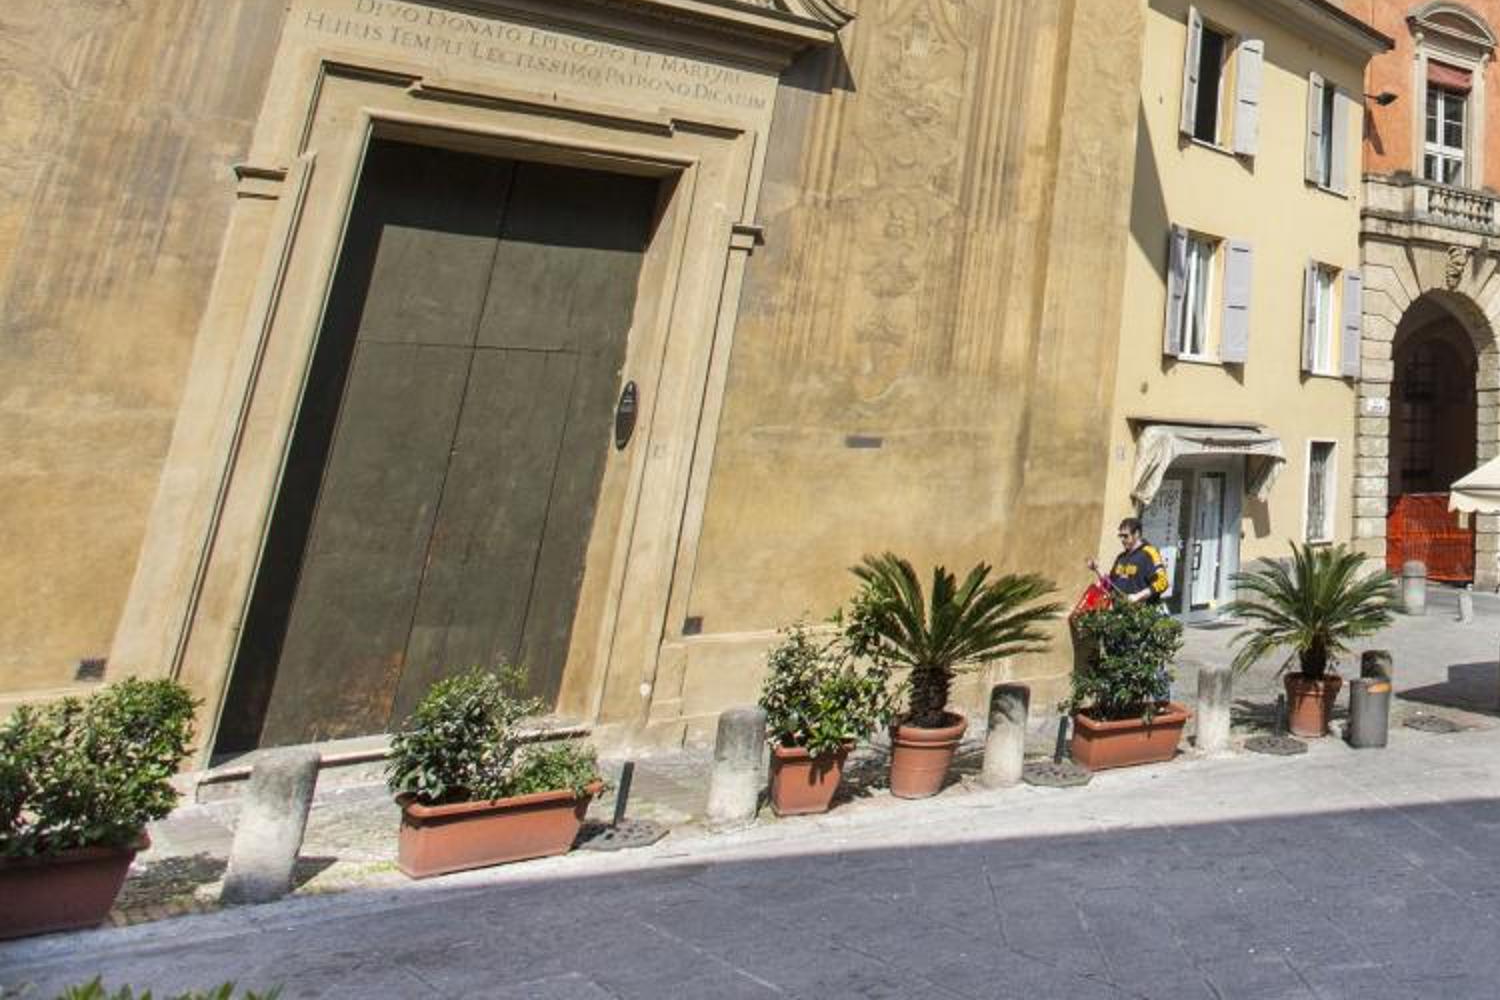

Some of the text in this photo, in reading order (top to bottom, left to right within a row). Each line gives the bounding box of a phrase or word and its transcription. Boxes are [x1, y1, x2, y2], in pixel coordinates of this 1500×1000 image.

[422, 9, 521, 42] DONATO
[528, 32, 625, 64] EPISCOPO
[604, 67, 691, 97] PATRONO
